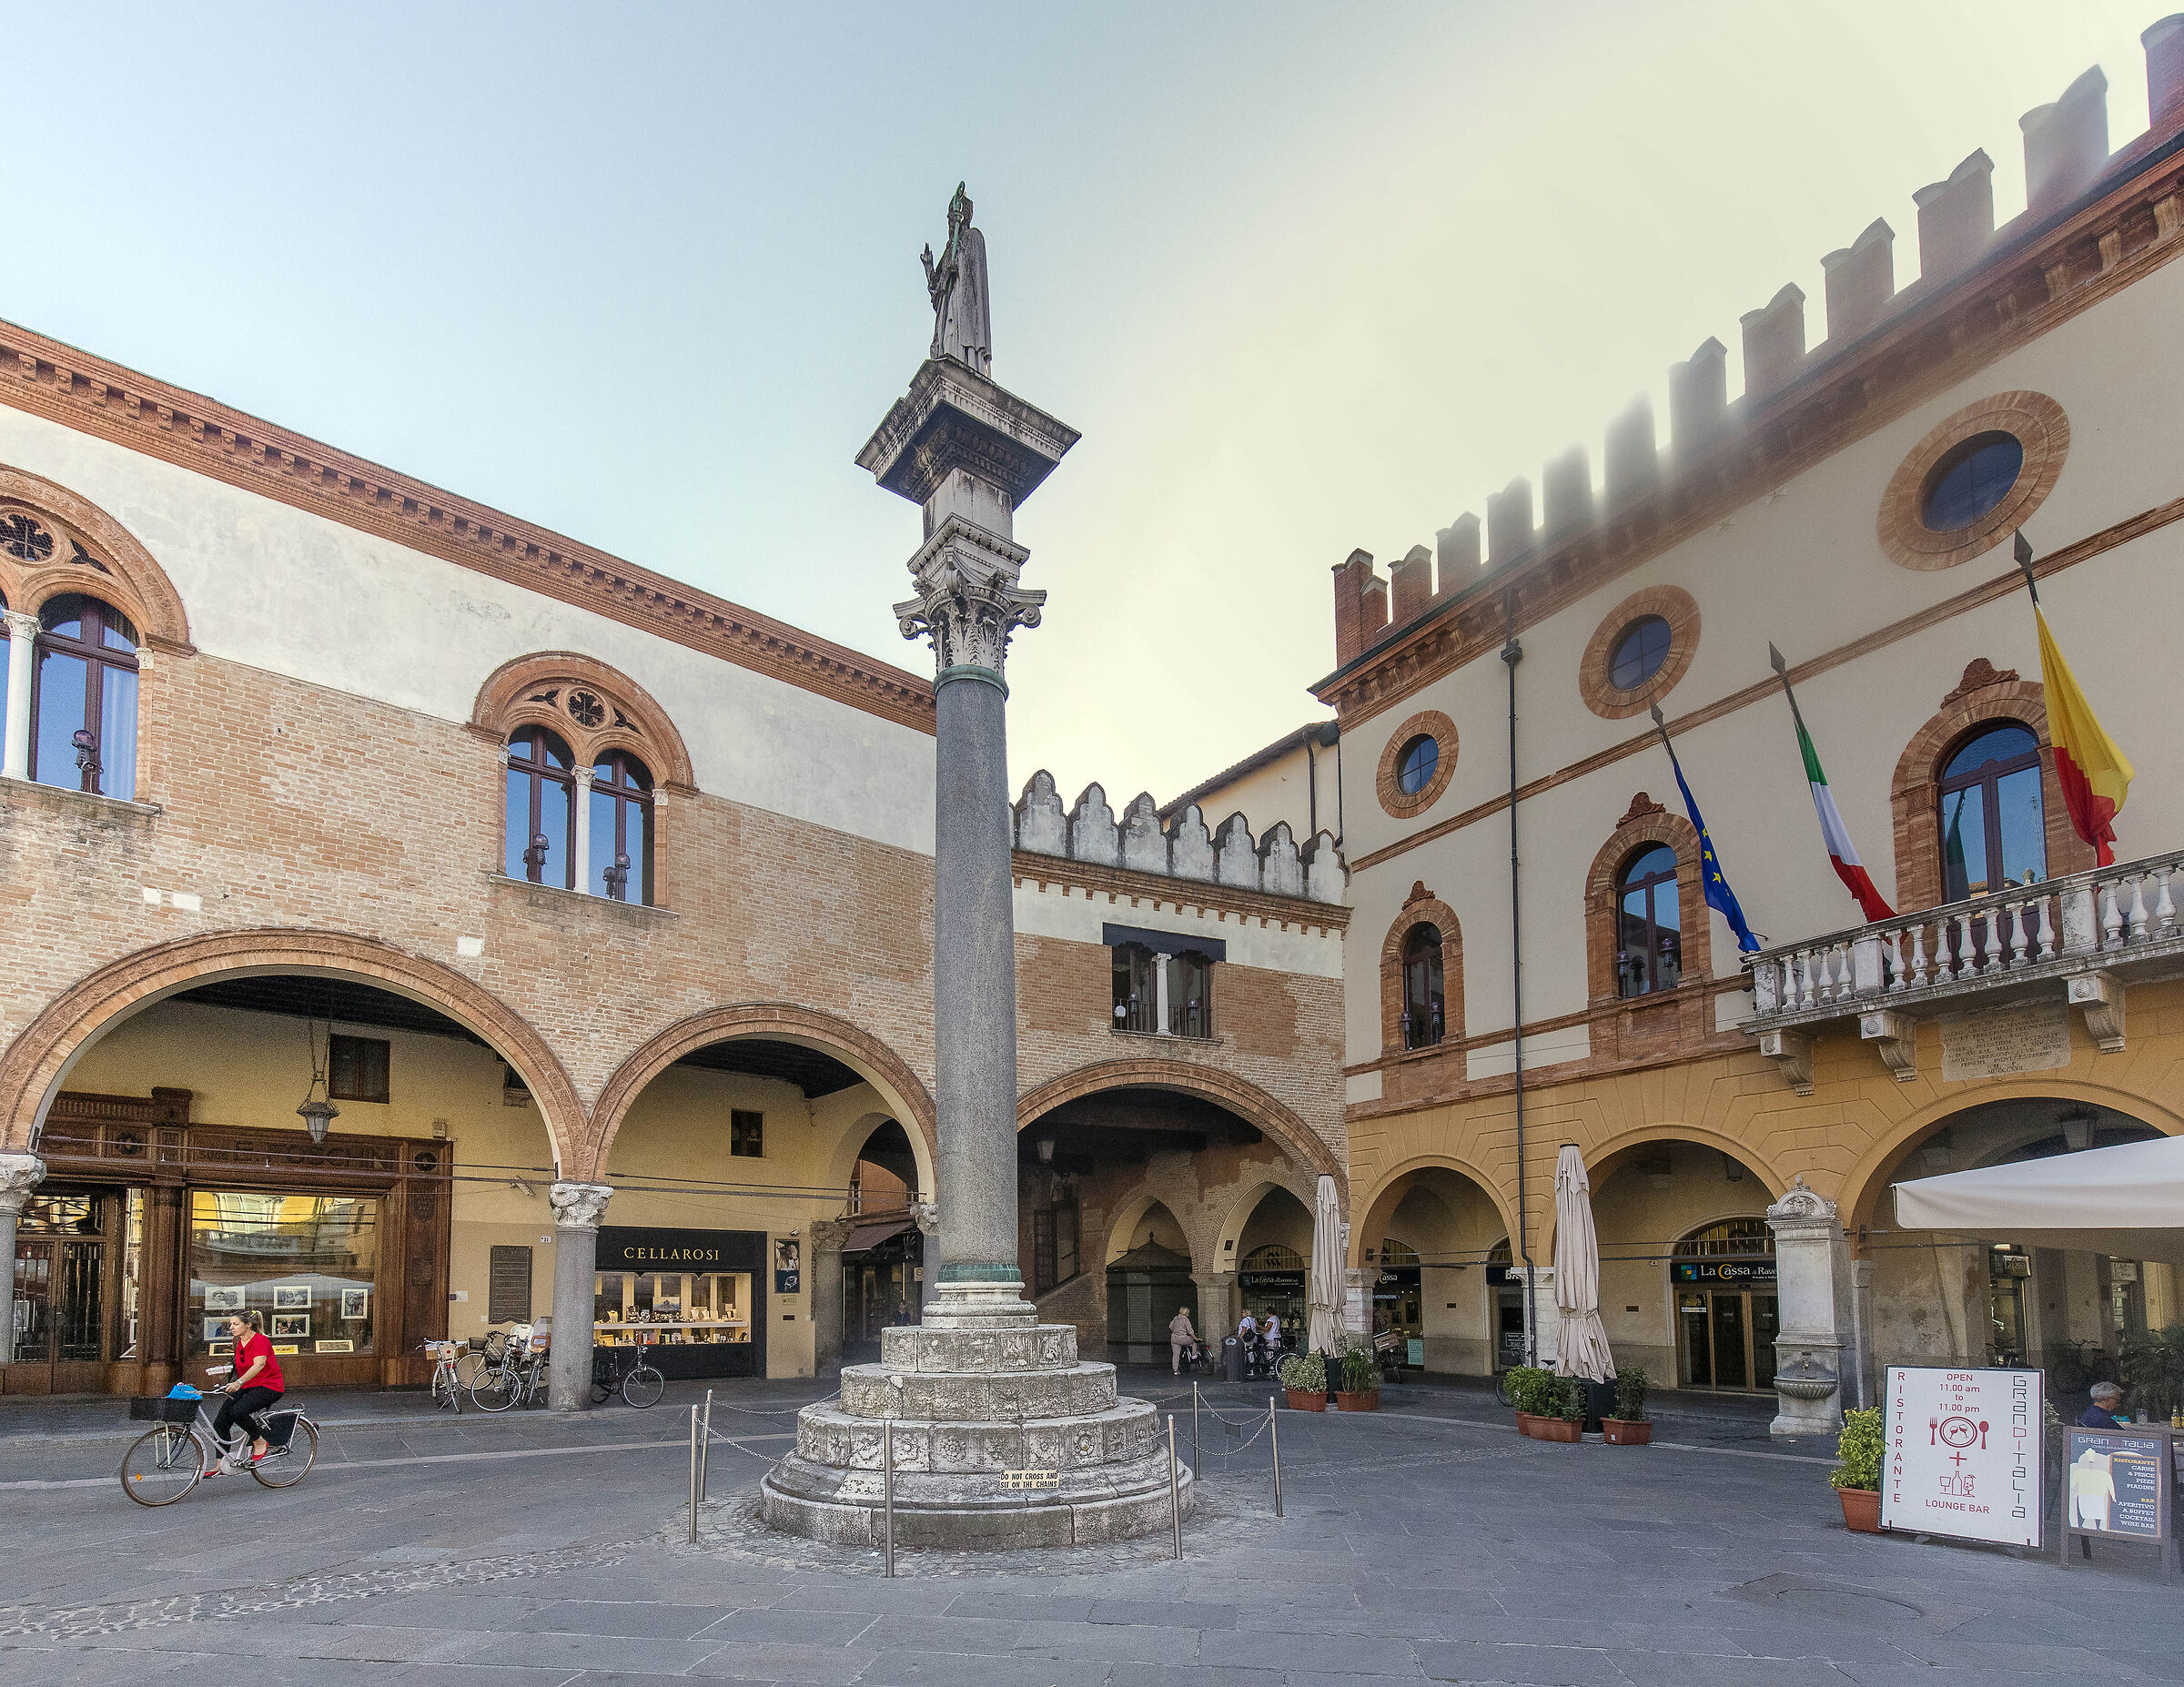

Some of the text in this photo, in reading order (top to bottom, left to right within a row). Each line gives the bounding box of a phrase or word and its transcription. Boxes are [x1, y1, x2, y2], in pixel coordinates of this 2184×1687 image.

[623, 1247, 719, 1260] CELLAROSI
[1701, 1265, 1716, 1276] La
[1718, 1264, 1750, 1279] Cassa
[1379, 1271, 1398, 1284] Cassa
[1946, 1373, 1973, 1381] OPEN
[1939, 1384, 1963, 1392] 11.00
[1939, 1403, 1962, 1411] 11.00
[1894, 1372, 1906, 1502] RISTORANTE
[1926, 1500, 1990, 1514] LOUNGE BAR
[2118, 1501, 2155, 1510] APERITIVO
[2119, 1514, 2155, 1522] COCKTAIL
